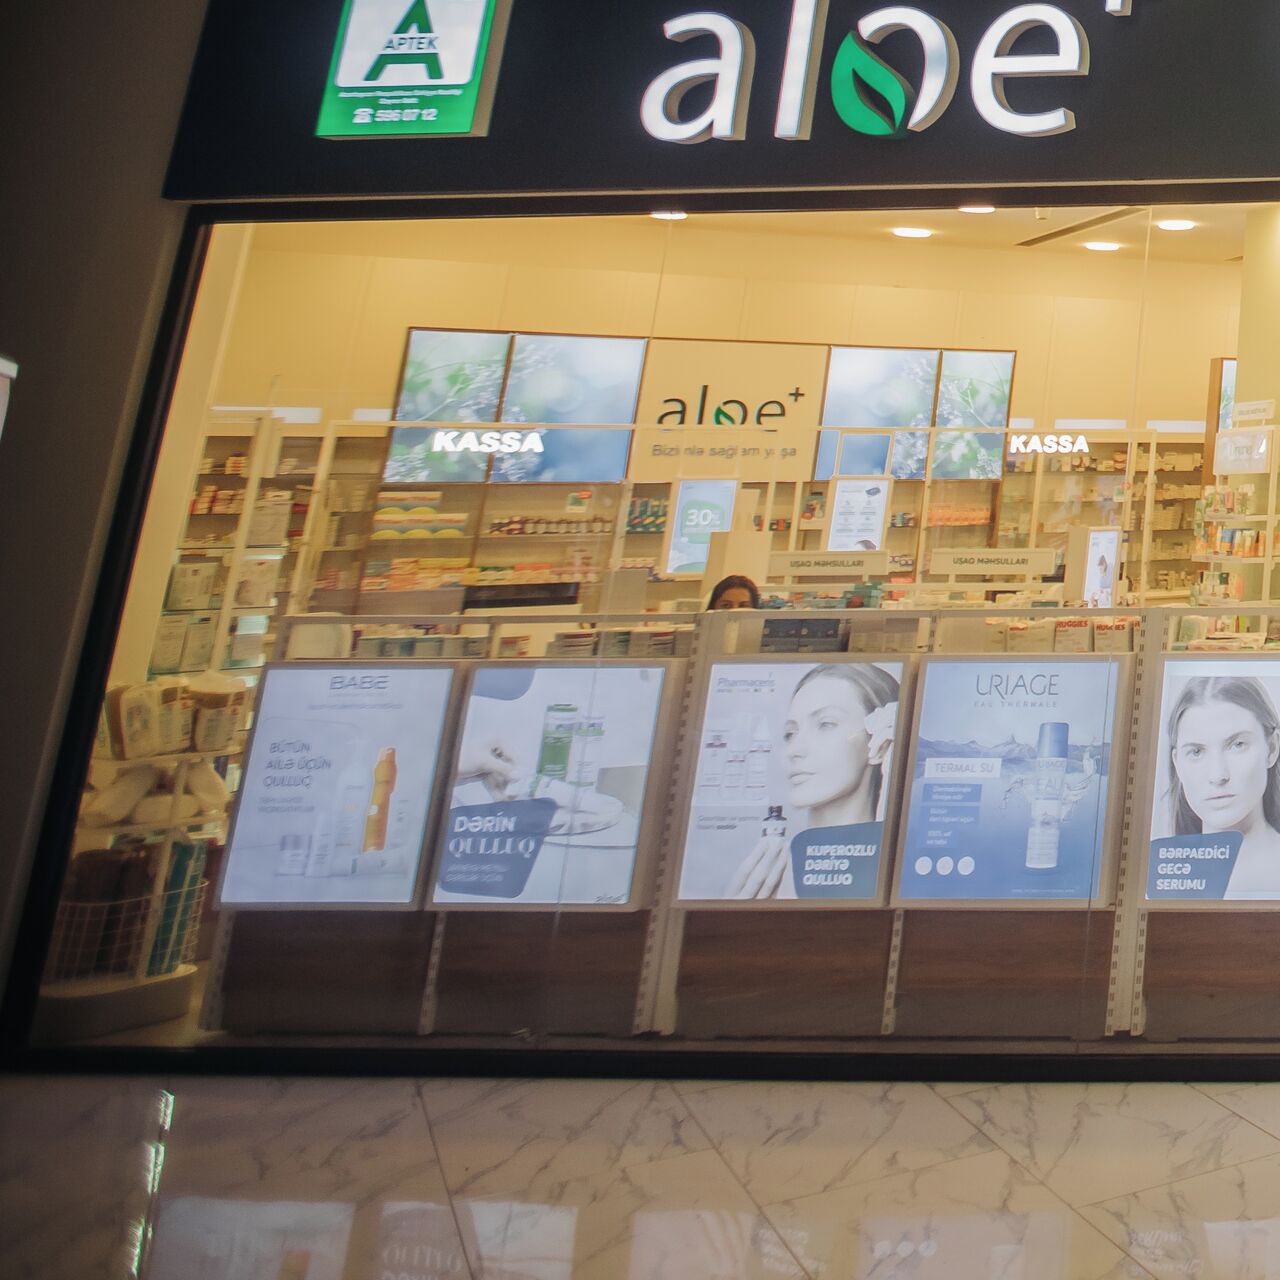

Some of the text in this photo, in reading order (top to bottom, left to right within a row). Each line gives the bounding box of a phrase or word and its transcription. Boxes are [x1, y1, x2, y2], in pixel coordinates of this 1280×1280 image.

[383, 36, 439, 51] APTEK
[432, 431, 545, 453] KASSA
[1010, 435, 1089, 453] KASSA
[1056, 620, 1088, 628] HUGGIES
[329, 675, 390, 690] BABE
[976, 674, 1059, 700] URIAGE
[935, 762, 994, 773] TERMAL SU
[449, 836, 536, 858] QULLUQ
[806, 844, 877, 856] KUPEROZLU
[802, 873, 853, 886] QULLUQ
[1156, 878, 1207, 891] SERUMU
